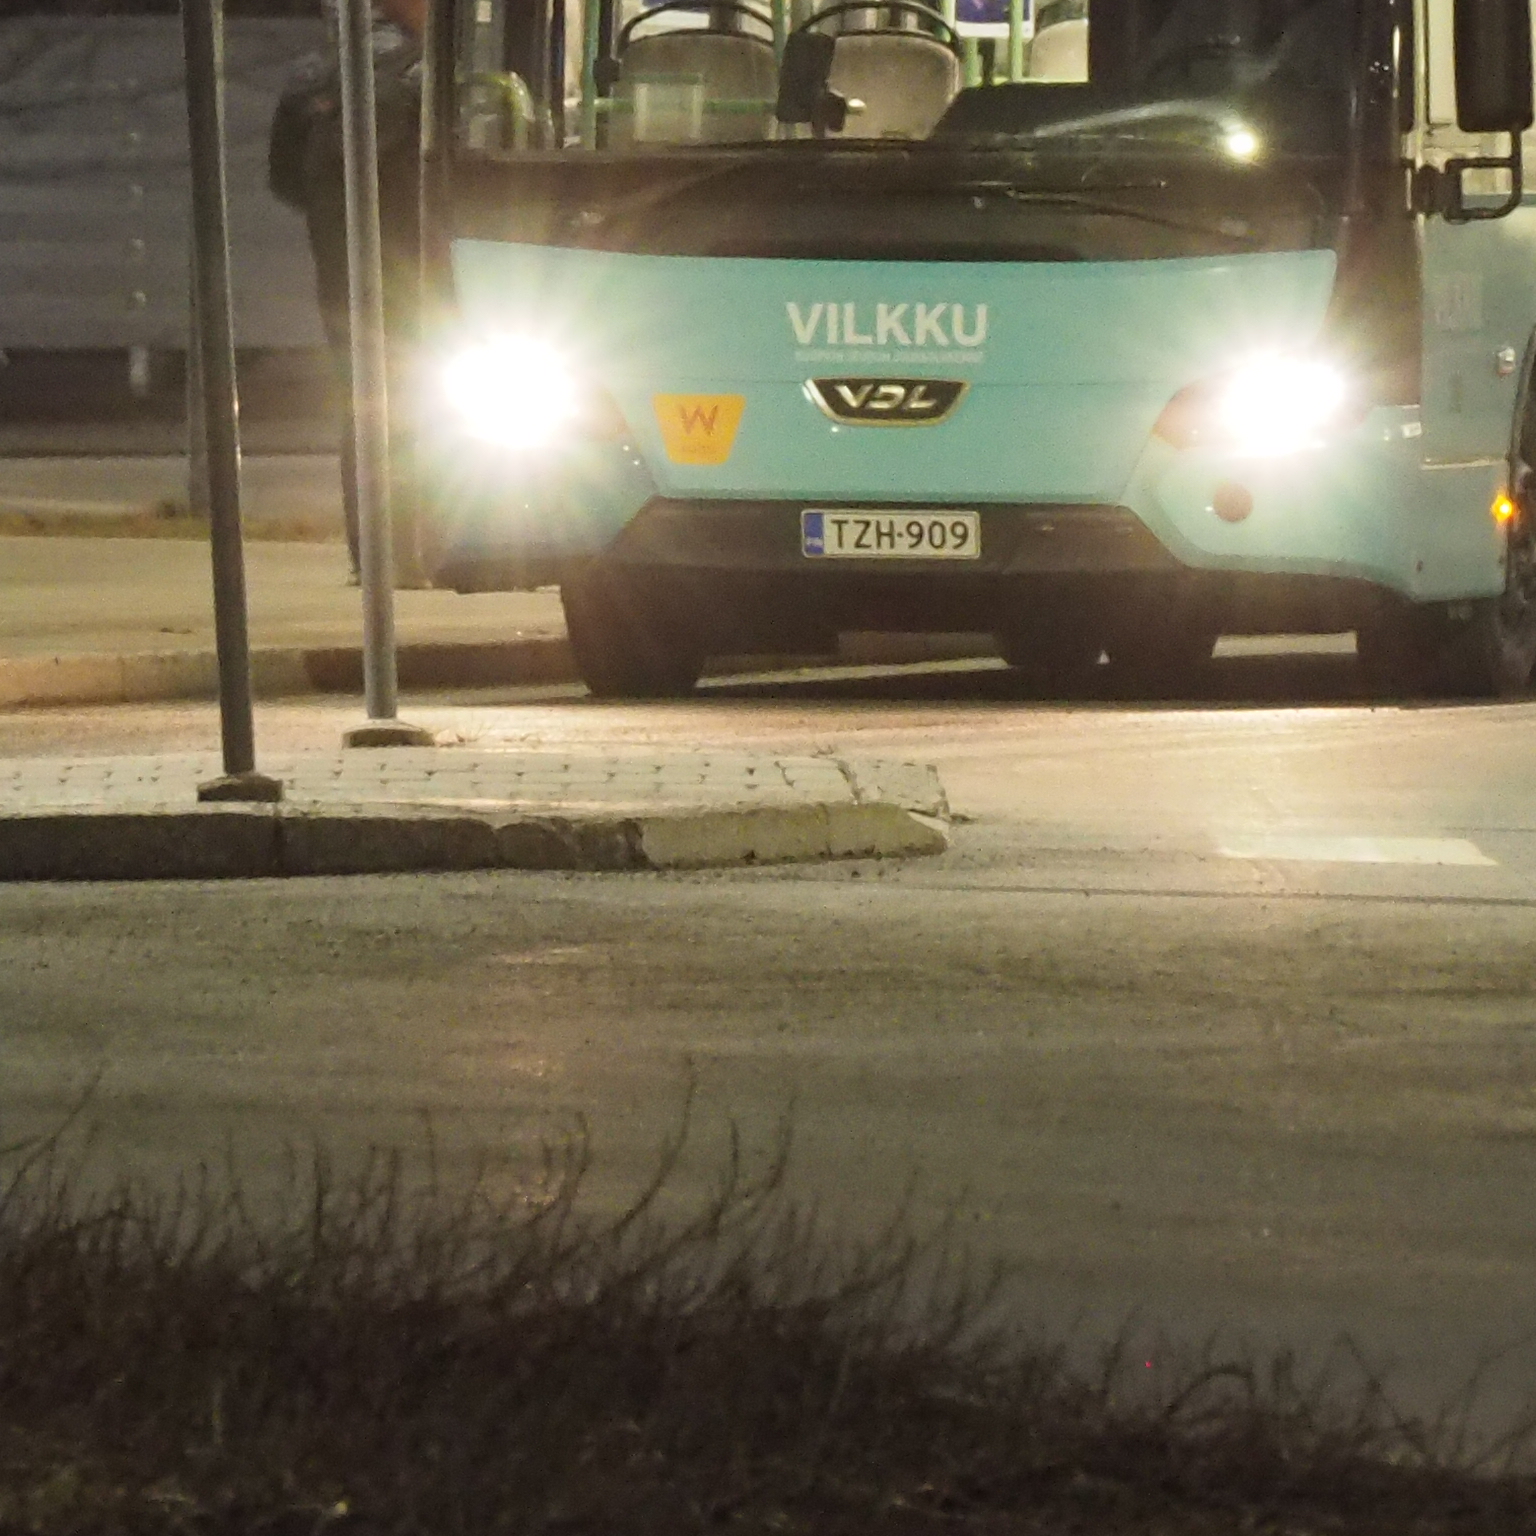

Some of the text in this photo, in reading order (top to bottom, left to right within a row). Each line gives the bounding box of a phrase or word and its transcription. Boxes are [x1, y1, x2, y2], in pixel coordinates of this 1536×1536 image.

[786, 301, 990, 347] VILKKU
[834, 383, 939, 411] VDL
[830, 519, 970, 550] TZH-909
